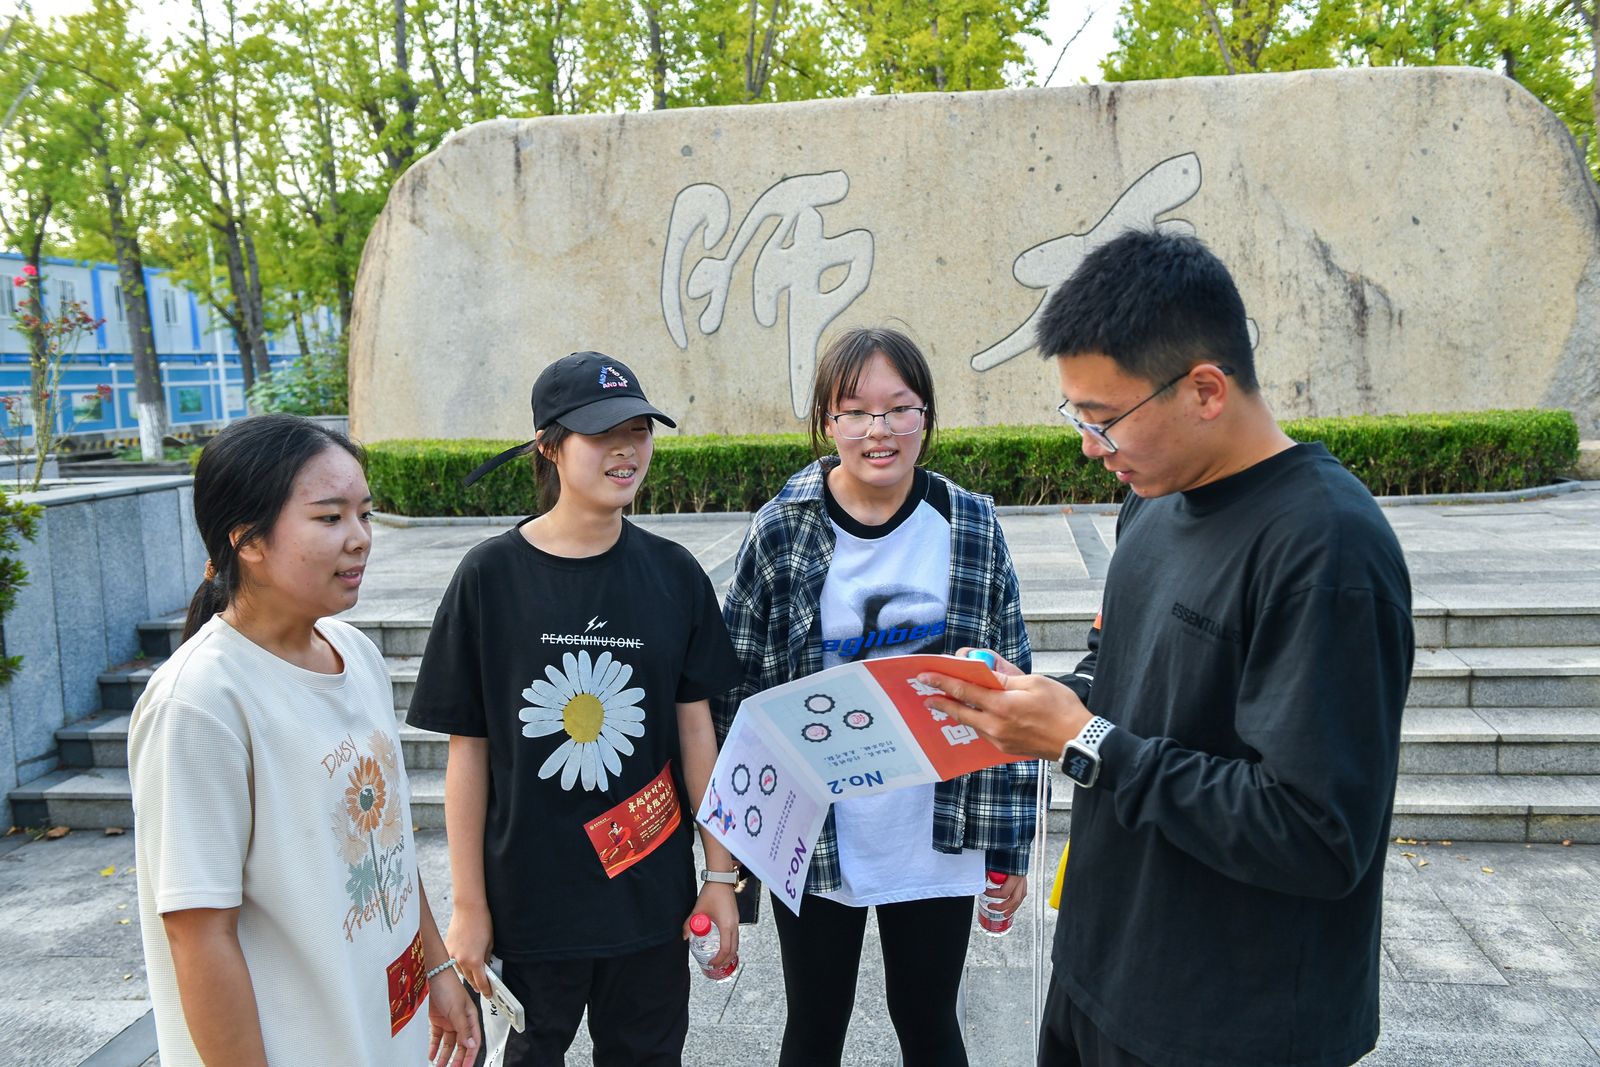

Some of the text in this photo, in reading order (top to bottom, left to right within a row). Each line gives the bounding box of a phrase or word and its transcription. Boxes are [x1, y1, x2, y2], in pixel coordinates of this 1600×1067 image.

[541, 633, 643, 649] PEACEMINUSONE
[827, 770, 884, 795] No.2
[785, 836, 807, 900] No.3
